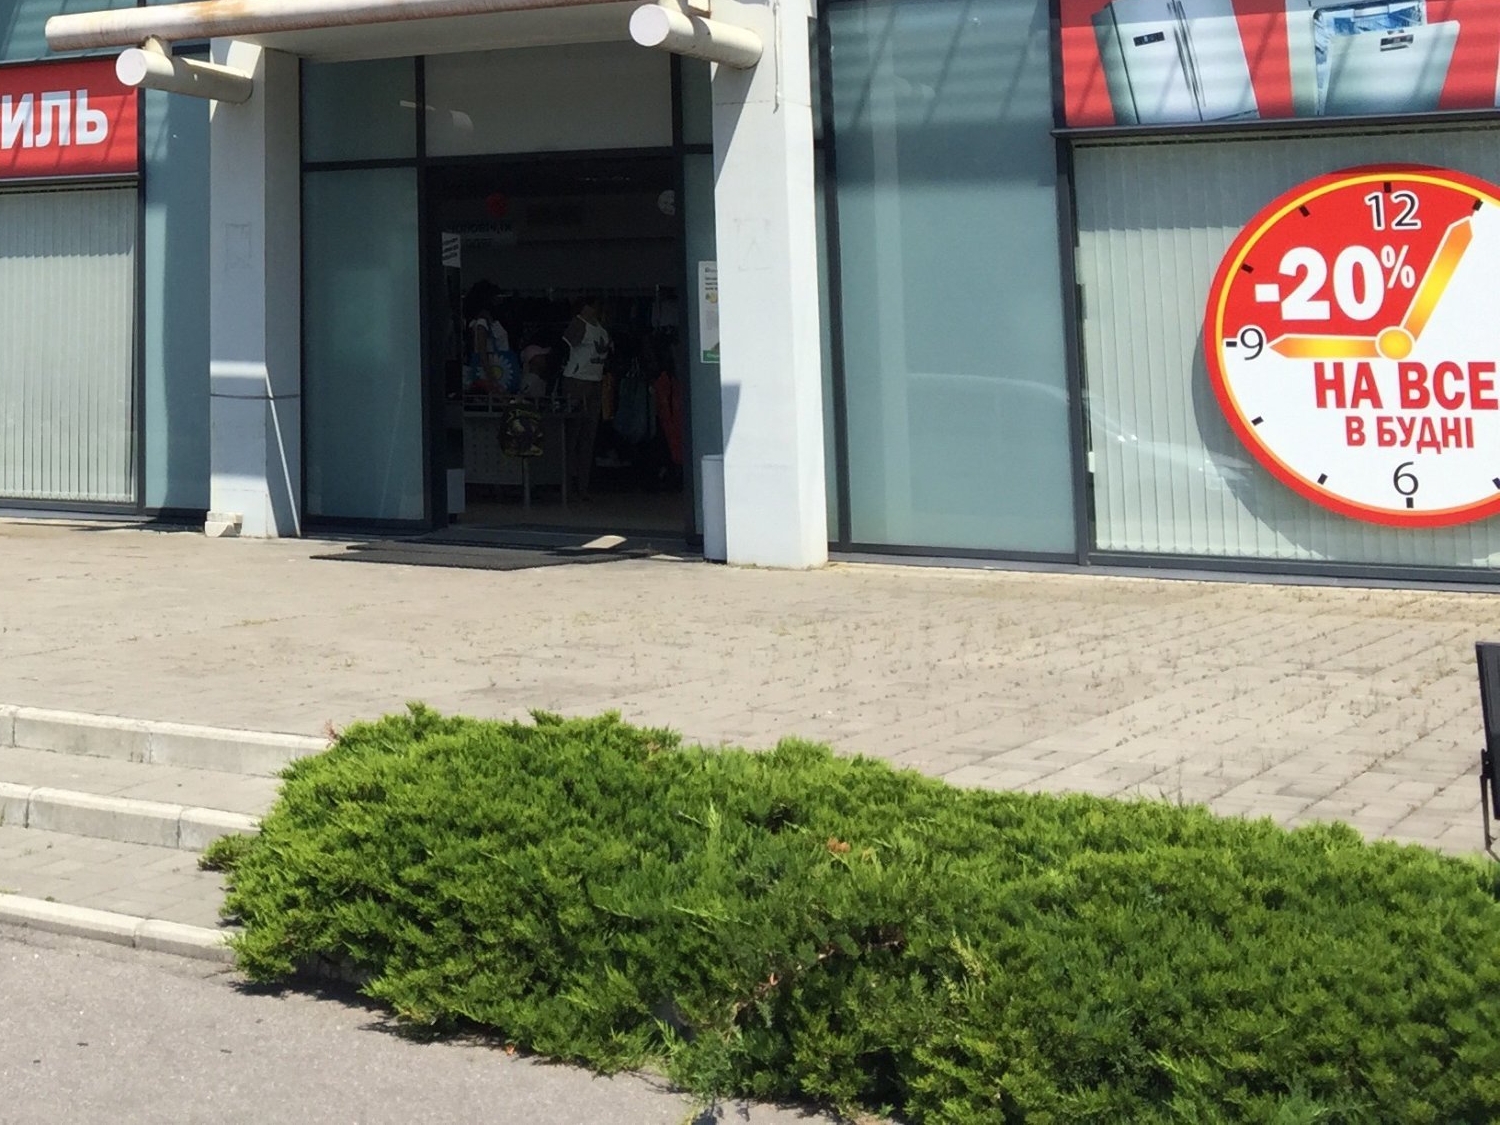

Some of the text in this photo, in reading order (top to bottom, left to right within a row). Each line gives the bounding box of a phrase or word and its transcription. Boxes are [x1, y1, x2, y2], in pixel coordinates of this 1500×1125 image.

[1366, 191, 1422, 230] 12
[1254, 245, 1417, 321] -20%
[1313, 360, 1499, 411] НА ВСЕ
[1345, 415, 1475, 455] В БУДНІ
[1393, 461, 1419, 496] 6
